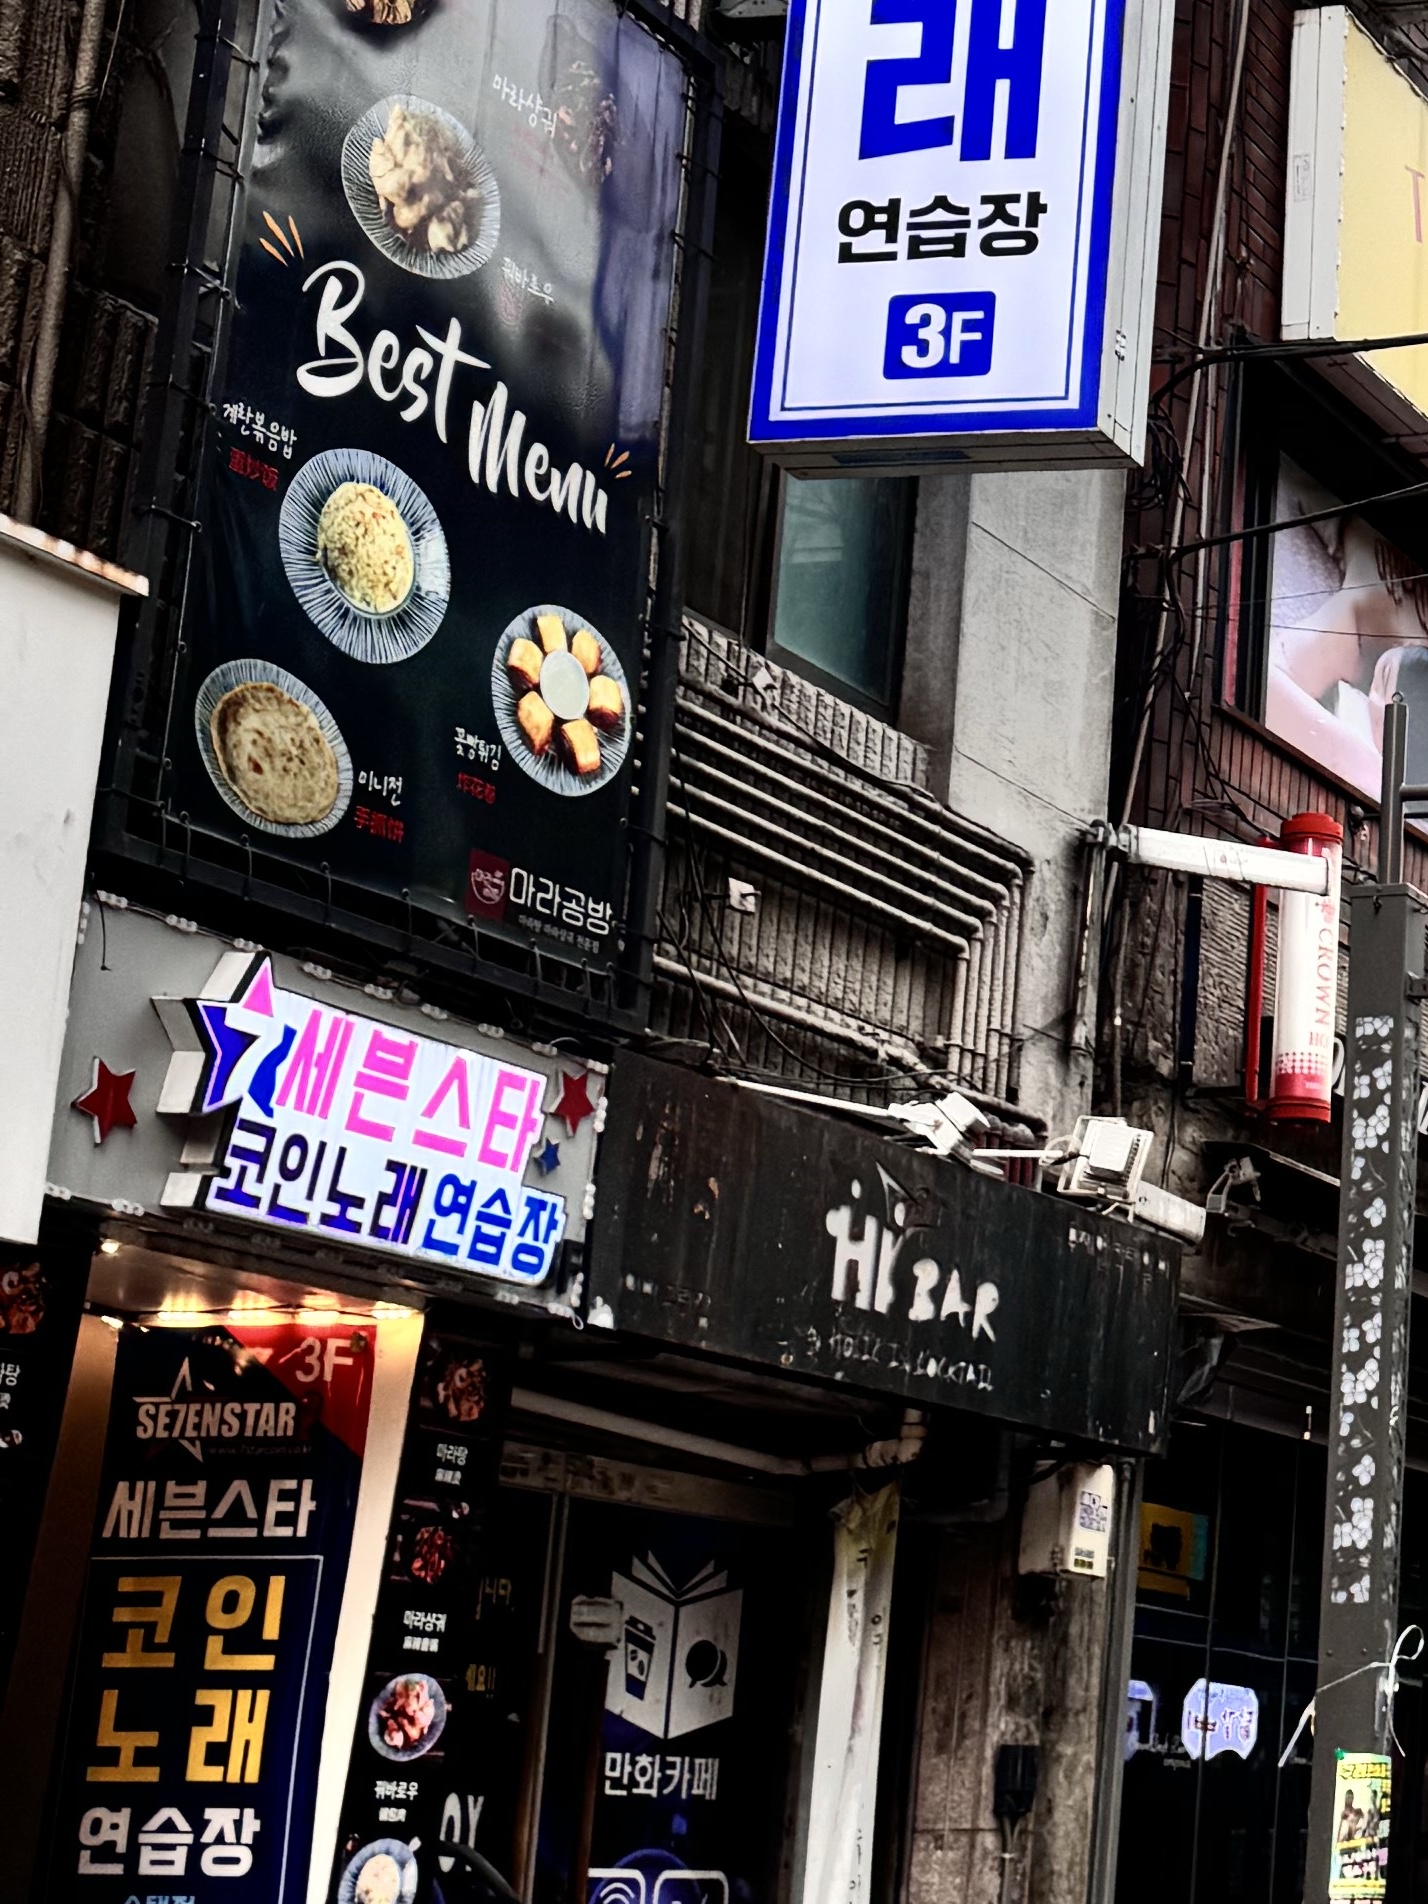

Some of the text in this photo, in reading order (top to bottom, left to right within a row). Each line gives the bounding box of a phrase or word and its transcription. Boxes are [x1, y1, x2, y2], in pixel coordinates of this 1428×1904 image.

[836, 193, 1048, 263] 연습장
[297, 261, 491, 443] Best
[901, 302, 985, 370] 3F
[467, 382, 607, 534] Menu
[358, 770, 402, 805] 미니전
[509, 867, 614, 935] 마라공방
[1315, 927, 1335, 1035] CROWN
[275, 1009, 544, 1173] 세븐스타
[295, 1338, 353, 1383] 3F
[102, 1479, 315, 1538] 세븐스타
[102, 1575, 285, 1671] 코인
[87, 1689, 270, 1784] 노래
[604, 1752, 719, 1800] 만화카페
[77, 1807, 260, 1877] 연습장
